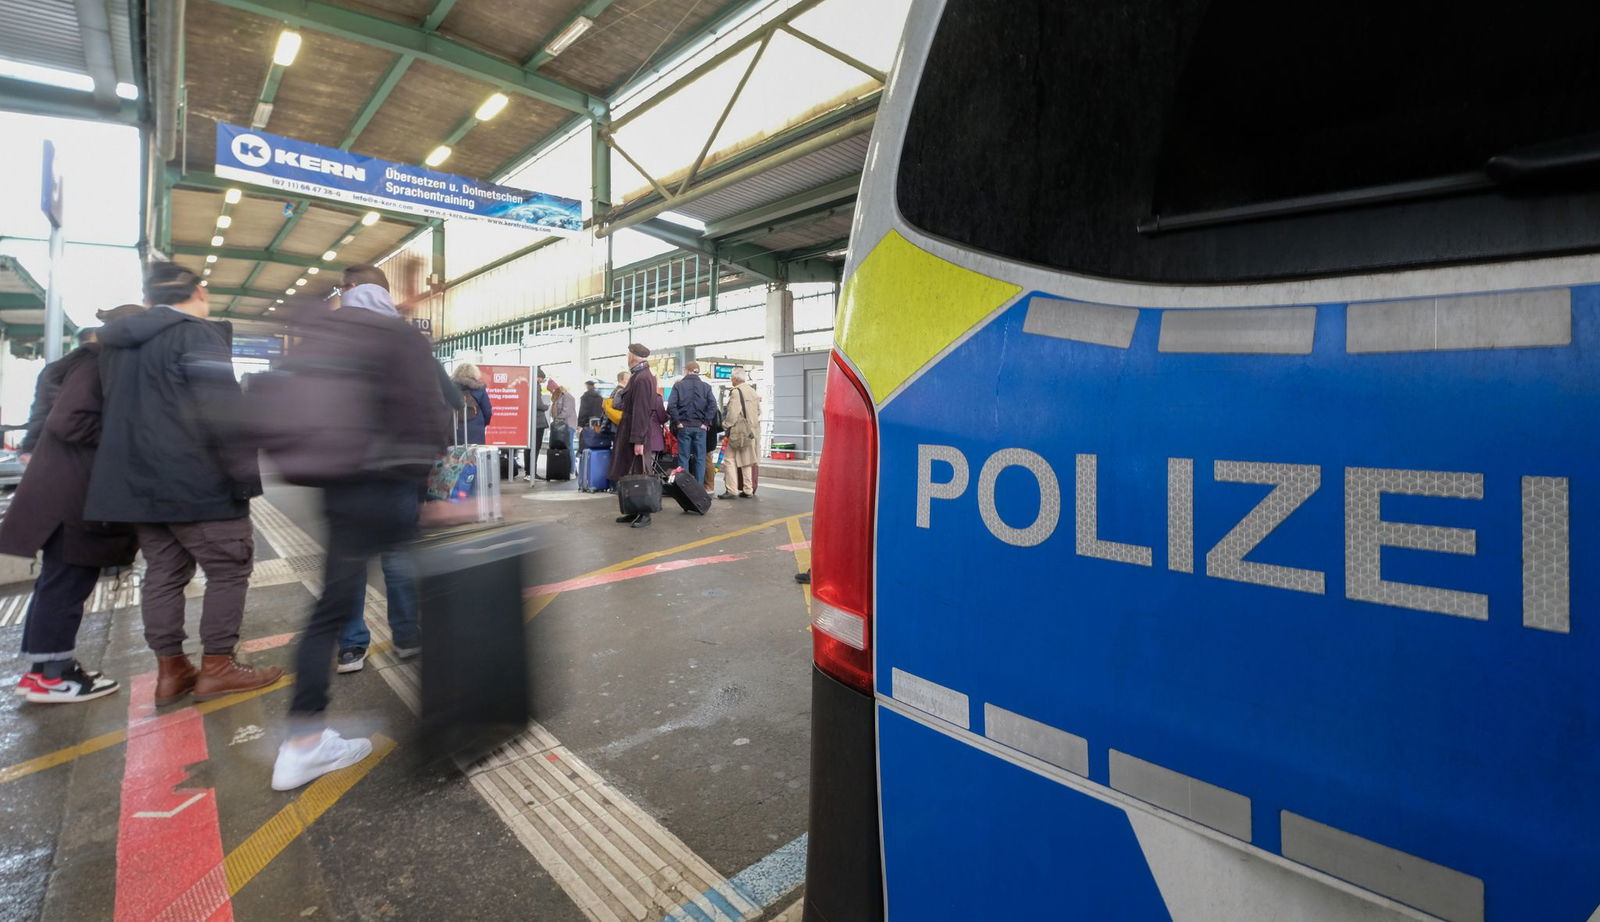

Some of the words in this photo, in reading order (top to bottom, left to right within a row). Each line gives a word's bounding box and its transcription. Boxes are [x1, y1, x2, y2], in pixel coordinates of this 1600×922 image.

[274, 149, 366, 182] KERN
[385, 167, 446, 190] Übersetzen
[449, 183, 459, 193] u.
[462, 185, 523, 204] Dolmetschen
[385, 182, 475, 210] Sprachentraining
[487, 218, 552, 233] www.kerntraining.com
[415, 319, 430, 330] 10
[916, 443, 1570, 634] POLIZEI
